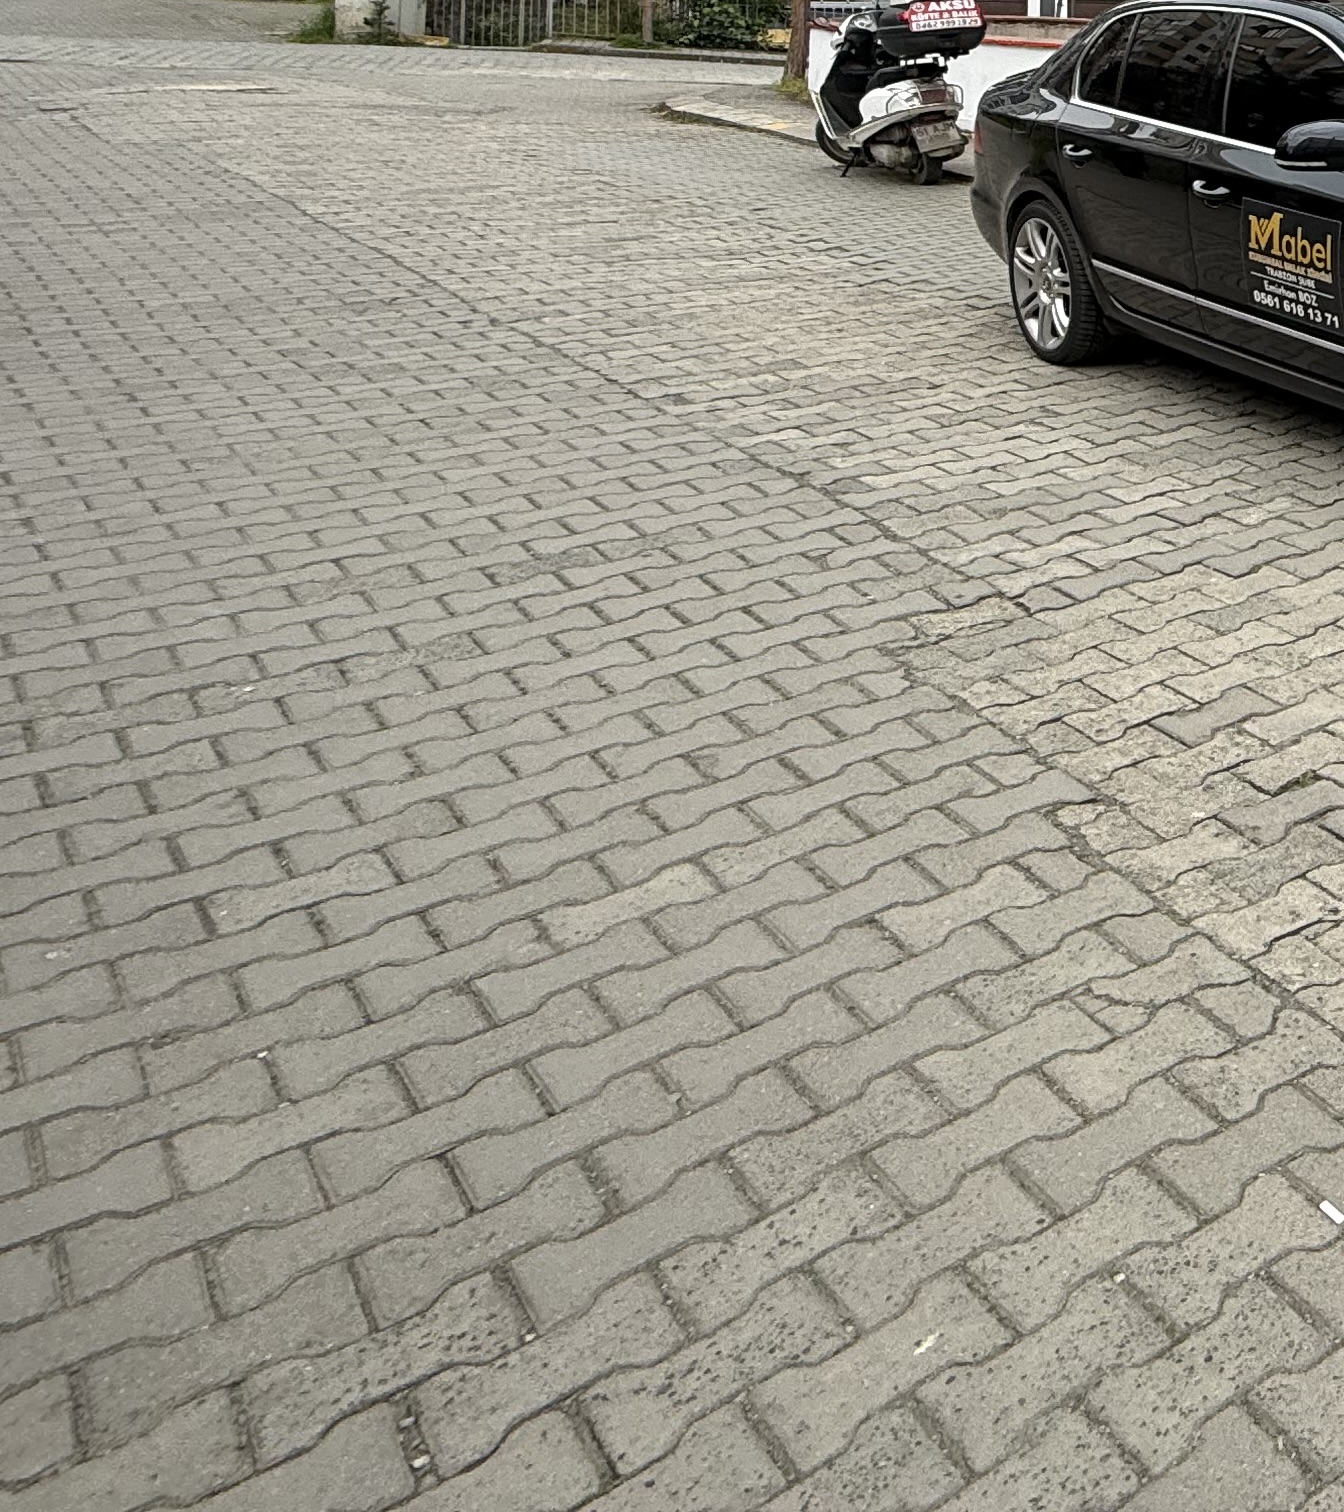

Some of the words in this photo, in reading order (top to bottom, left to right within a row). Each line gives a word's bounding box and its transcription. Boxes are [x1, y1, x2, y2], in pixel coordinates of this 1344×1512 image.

[928, 0, 976, 12] AKSU
[1248, 211, 1332, 271] Mabel
[1298, 290, 1319, 307] BOZ
[1307, 307, 1322, 323] 13
[1324, 313, 1340, 329] 71
